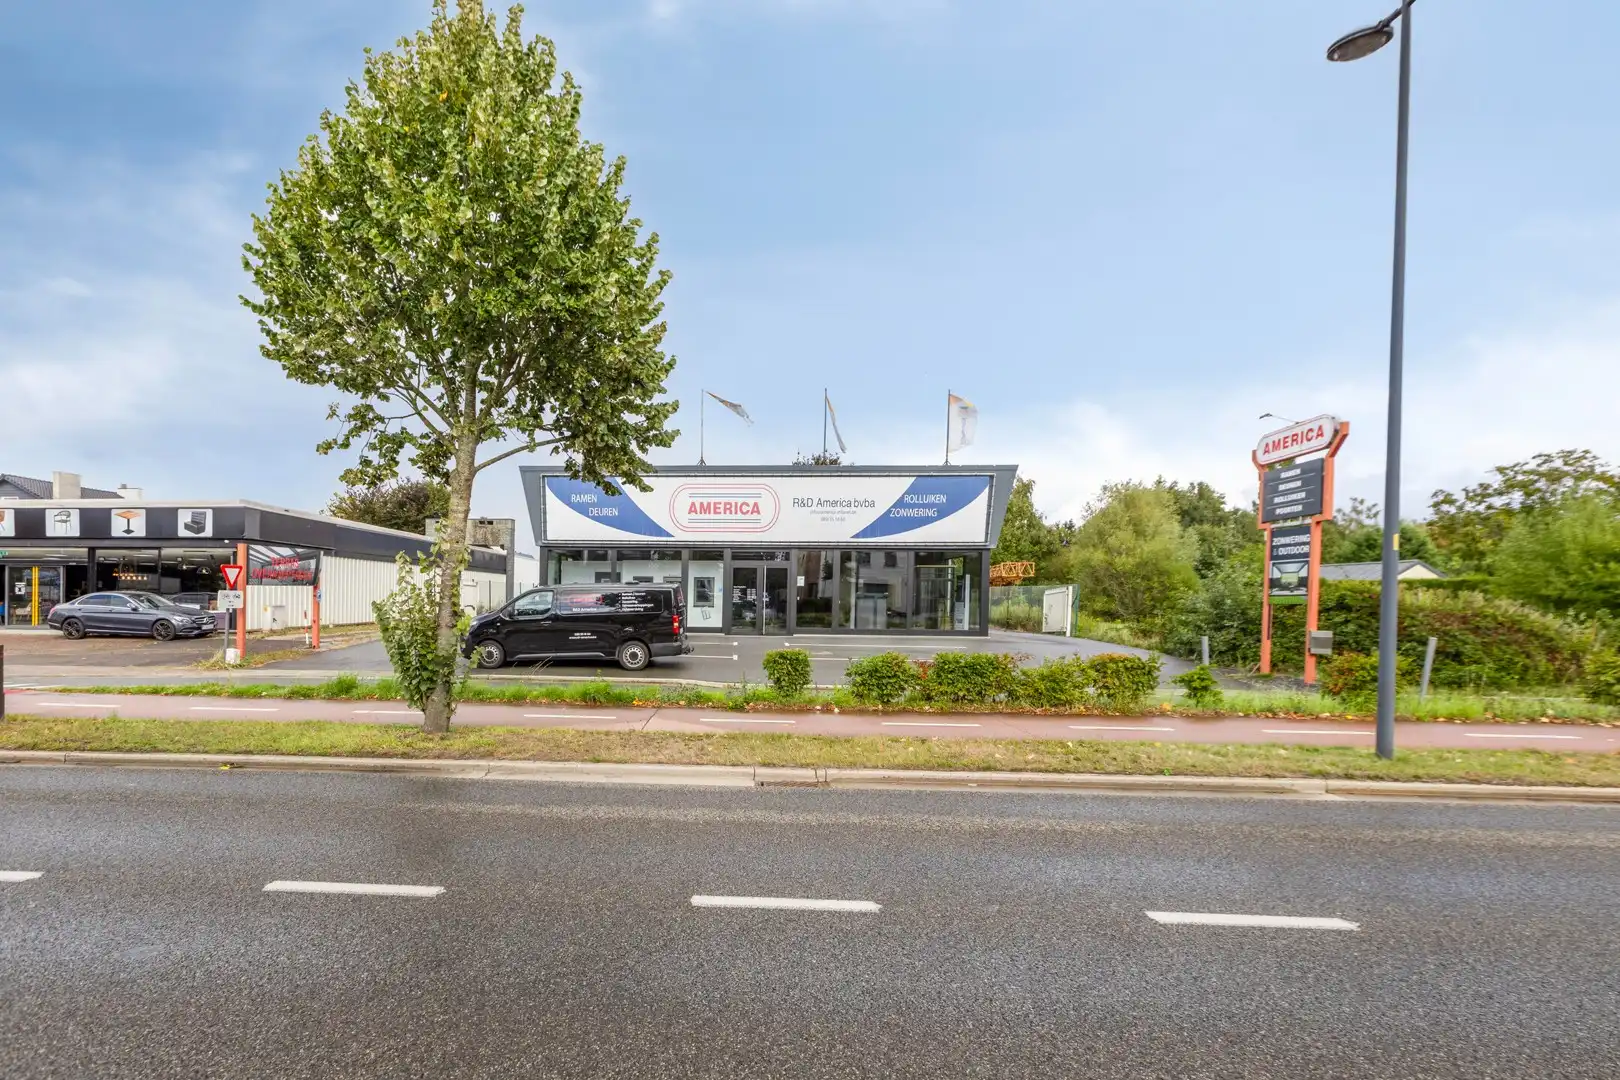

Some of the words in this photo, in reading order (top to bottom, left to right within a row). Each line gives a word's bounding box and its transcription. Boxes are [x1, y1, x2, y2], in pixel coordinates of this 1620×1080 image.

[1263, 424, 1325, 456] AMERICA
[571, 493, 597, 504] RAMEN
[792, 497, 814, 508] R&D
[816, 497, 852, 508] America
[853, 497, 876, 508] bvba
[903, 494, 947, 504] ROLLUIKEN
[588, 507, 619, 517] DEUREN
[687, 501, 761, 516] AMERICA
[890, 507, 938, 518] ZONWERING
[1272, 533, 1311, 546] ZONWERING
[1278, 545, 1310, 556] OUTDOOR
